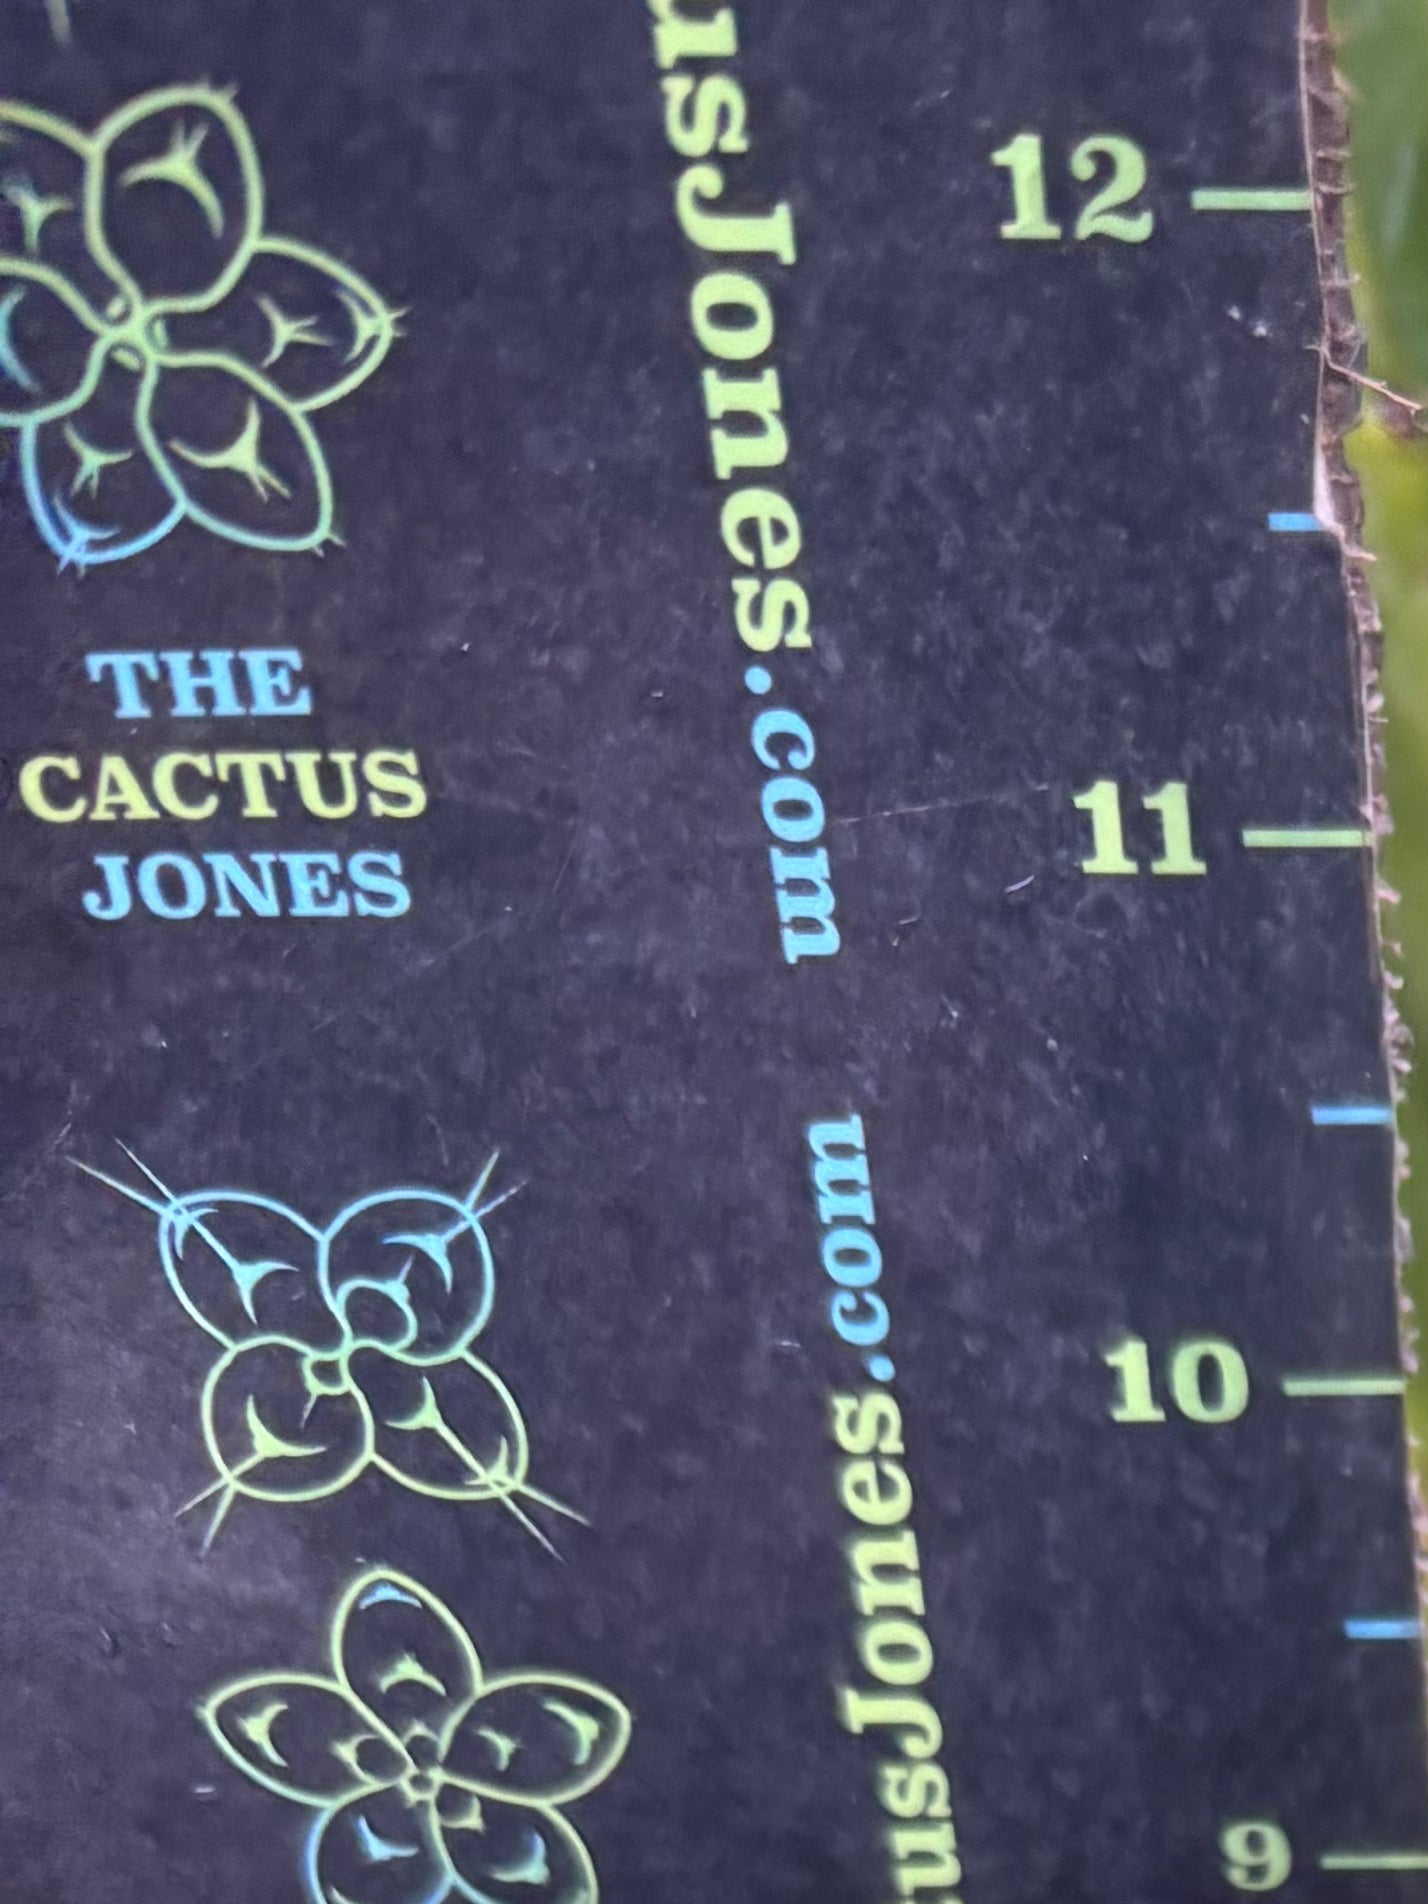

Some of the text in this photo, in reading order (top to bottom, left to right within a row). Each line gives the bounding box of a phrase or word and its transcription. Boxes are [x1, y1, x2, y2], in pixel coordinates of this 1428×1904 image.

[991, 133, 1154, 243] 12
[86, 648, 313, 720] THE
[18, 748, 428, 824] CACTUS
[1073, 779, 1207, 875] 11
[82, 850, 412, 921] JONES
[1105, 1338, 1251, 1424] 10
[1220, 1820, 1292, 1891] 9
